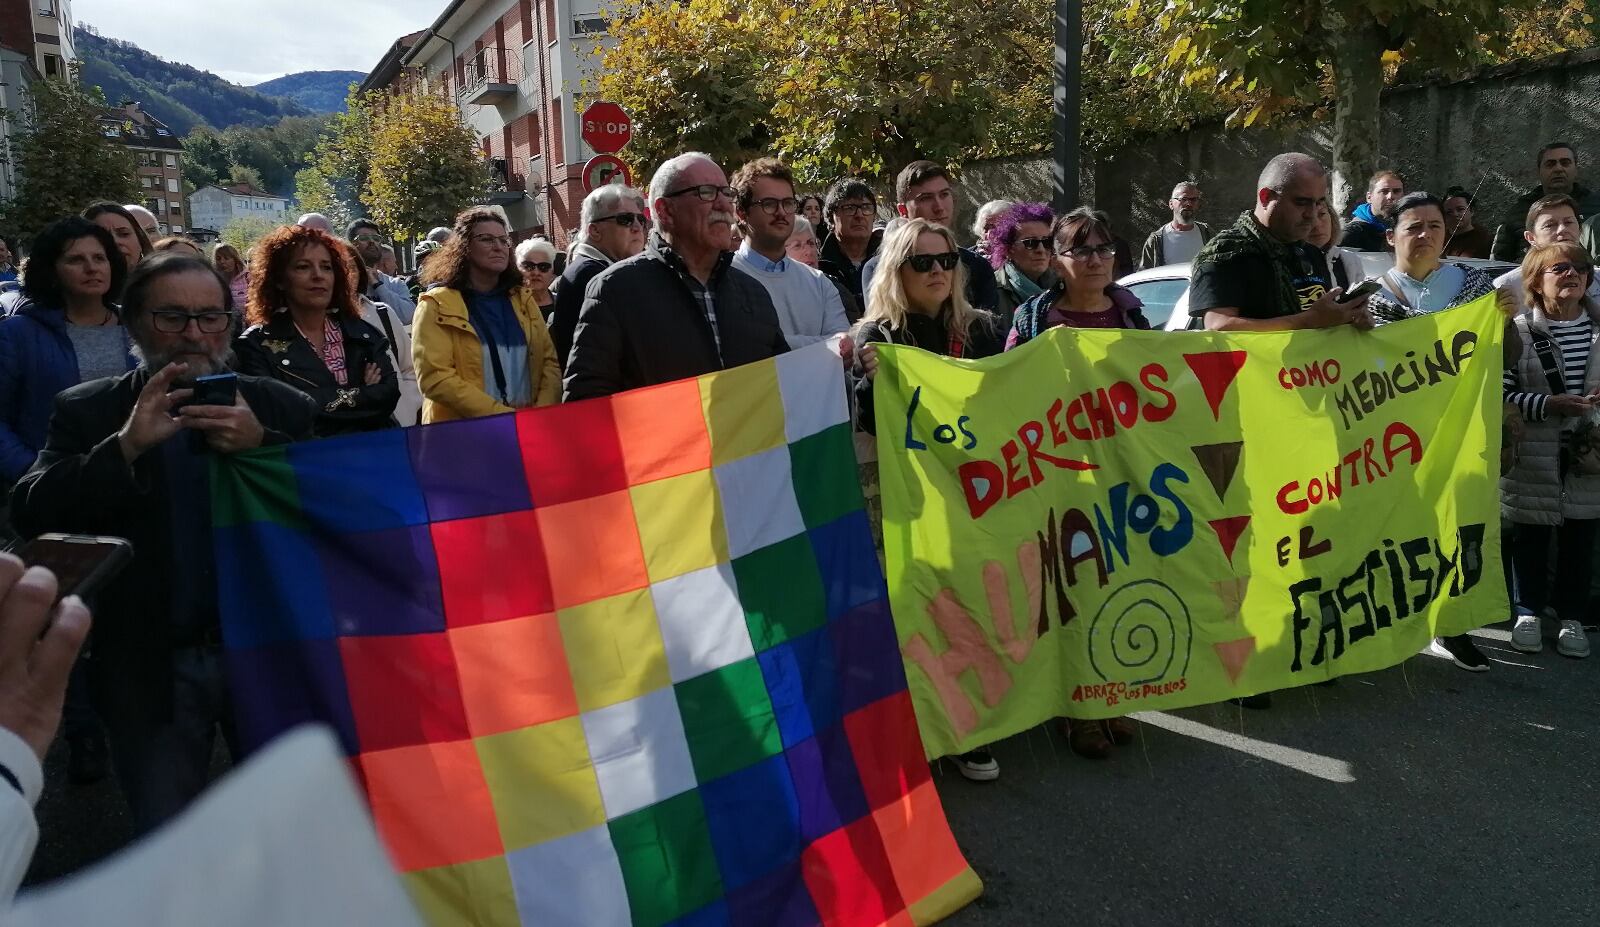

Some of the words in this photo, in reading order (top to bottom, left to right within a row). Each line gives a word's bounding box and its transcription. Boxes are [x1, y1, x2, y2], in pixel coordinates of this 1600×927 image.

[585, 120, 628, 135] STOP
[1278, 358, 1341, 391] COMO
[958, 362, 1177, 519] DERECHOS
[1275, 421, 1424, 516] CONTRA
[1275, 526, 1332, 568] EL
[903, 462, 1194, 744] HUMANOS
[1072, 682, 1127, 702] ABRAZO
[1106, 695, 1120, 706] DE
[1125, 689, 1140, 700] LOS
[1142, 678, 1187, 699] PUEBLOS
